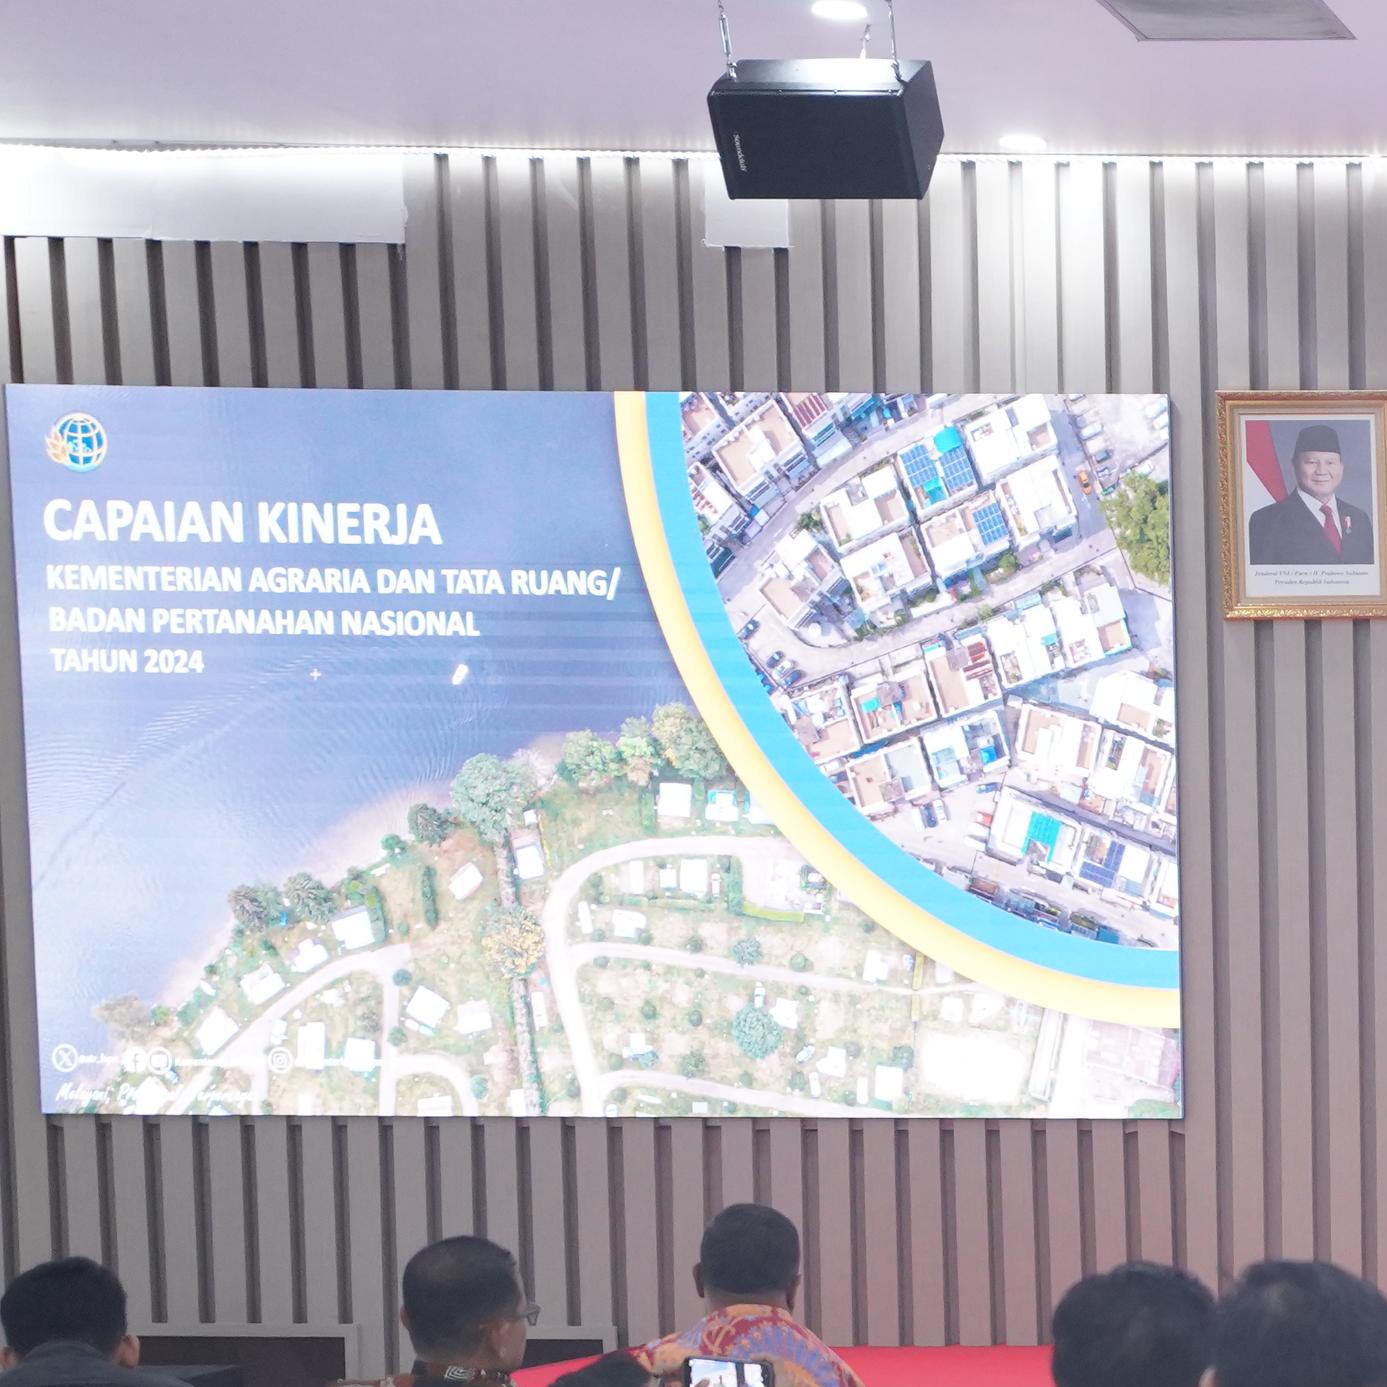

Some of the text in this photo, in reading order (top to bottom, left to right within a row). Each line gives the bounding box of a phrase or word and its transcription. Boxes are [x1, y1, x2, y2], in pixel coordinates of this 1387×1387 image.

[43, 498, 443, 545] CAPAIAN KINERJA
[45, 563, 621, 601] KEMENTERIAN AGRARIA DAN TATA RUANG/
[48, 607, 481, 637] BADAN PERTANAHAN NASIONAL
[50, 647, 205, 674] TAHUN 2024
